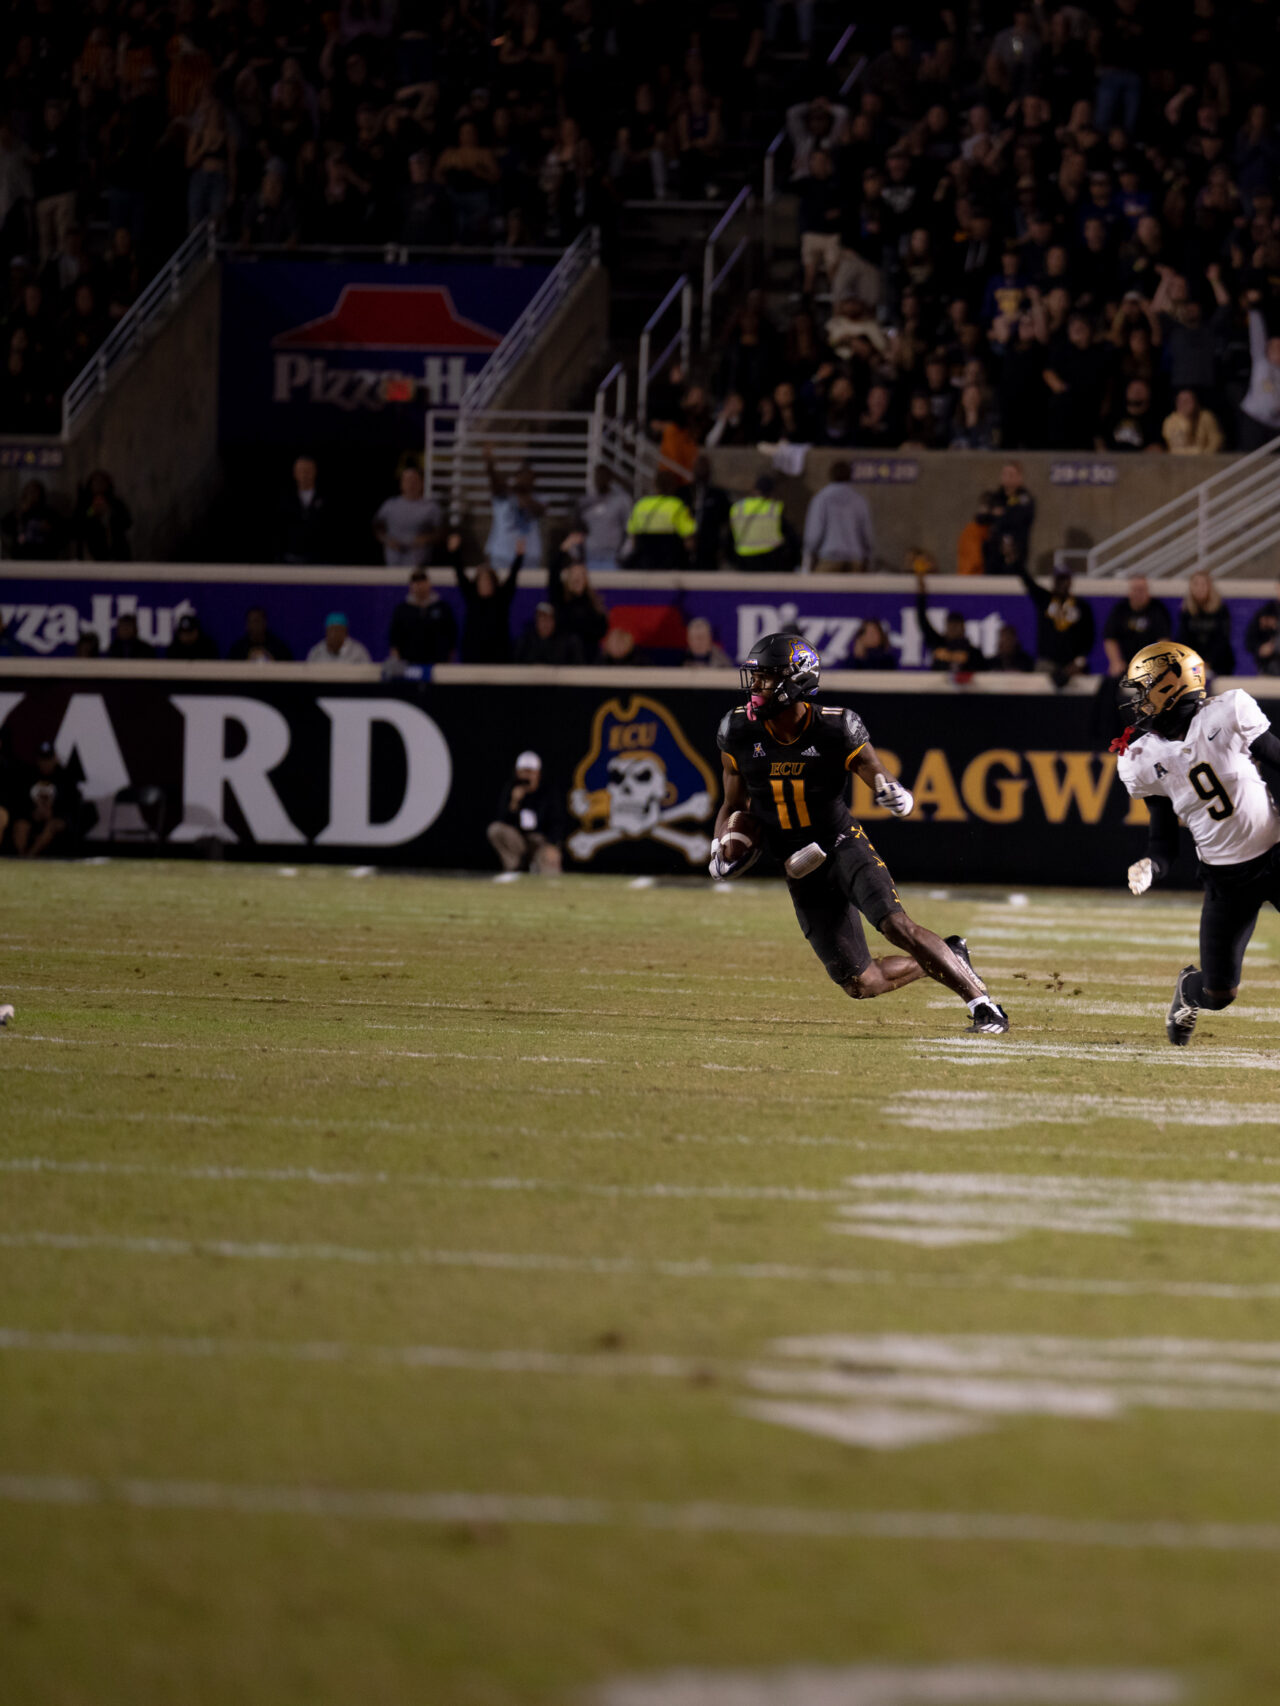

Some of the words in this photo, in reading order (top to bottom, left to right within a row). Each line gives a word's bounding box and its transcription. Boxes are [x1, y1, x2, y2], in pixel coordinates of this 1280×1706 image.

[736, 602, 891, 667] Pzz
[607, 720, 658, 751] ECU
[769, 761, 806, 776] ECU
[851, 748, 1188, 826] BAGW
[1189, 762, 1234, 821] 9
[769, 779, 812, 830] 11
